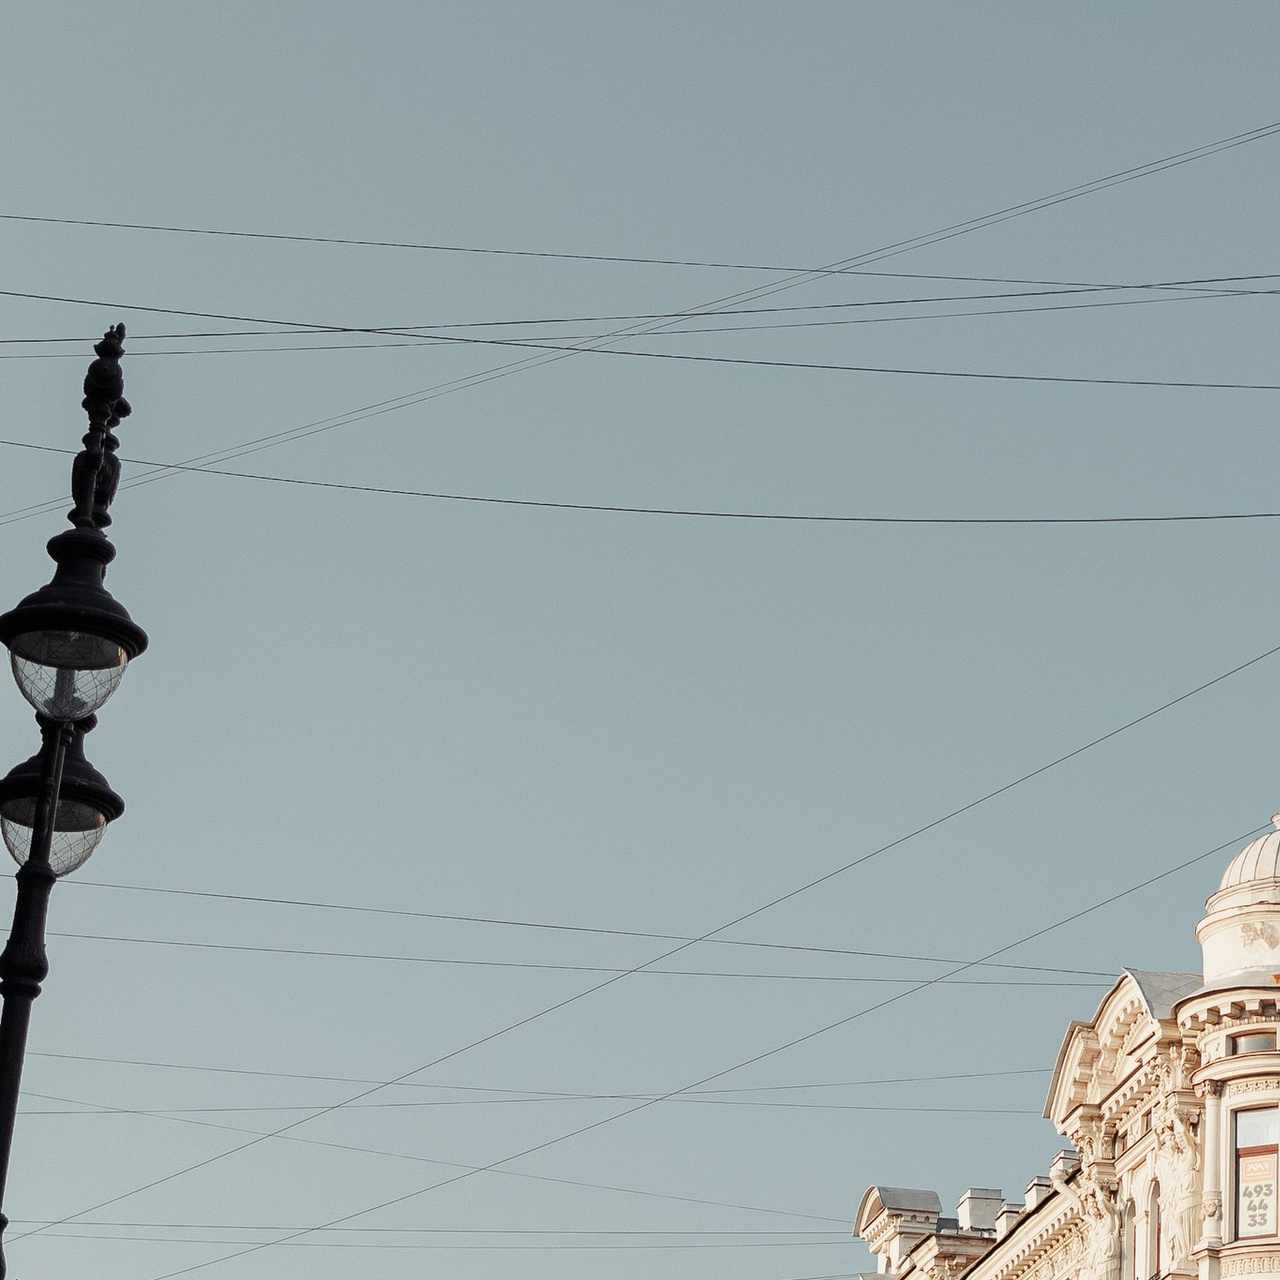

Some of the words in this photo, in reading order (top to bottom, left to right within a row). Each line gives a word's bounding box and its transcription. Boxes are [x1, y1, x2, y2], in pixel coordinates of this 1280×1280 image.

[1243, 1183, 1273, 1198] 493
[1247, 1199, 1268, 1212] 44
[1247, 1213, 1268, 1228] 33
